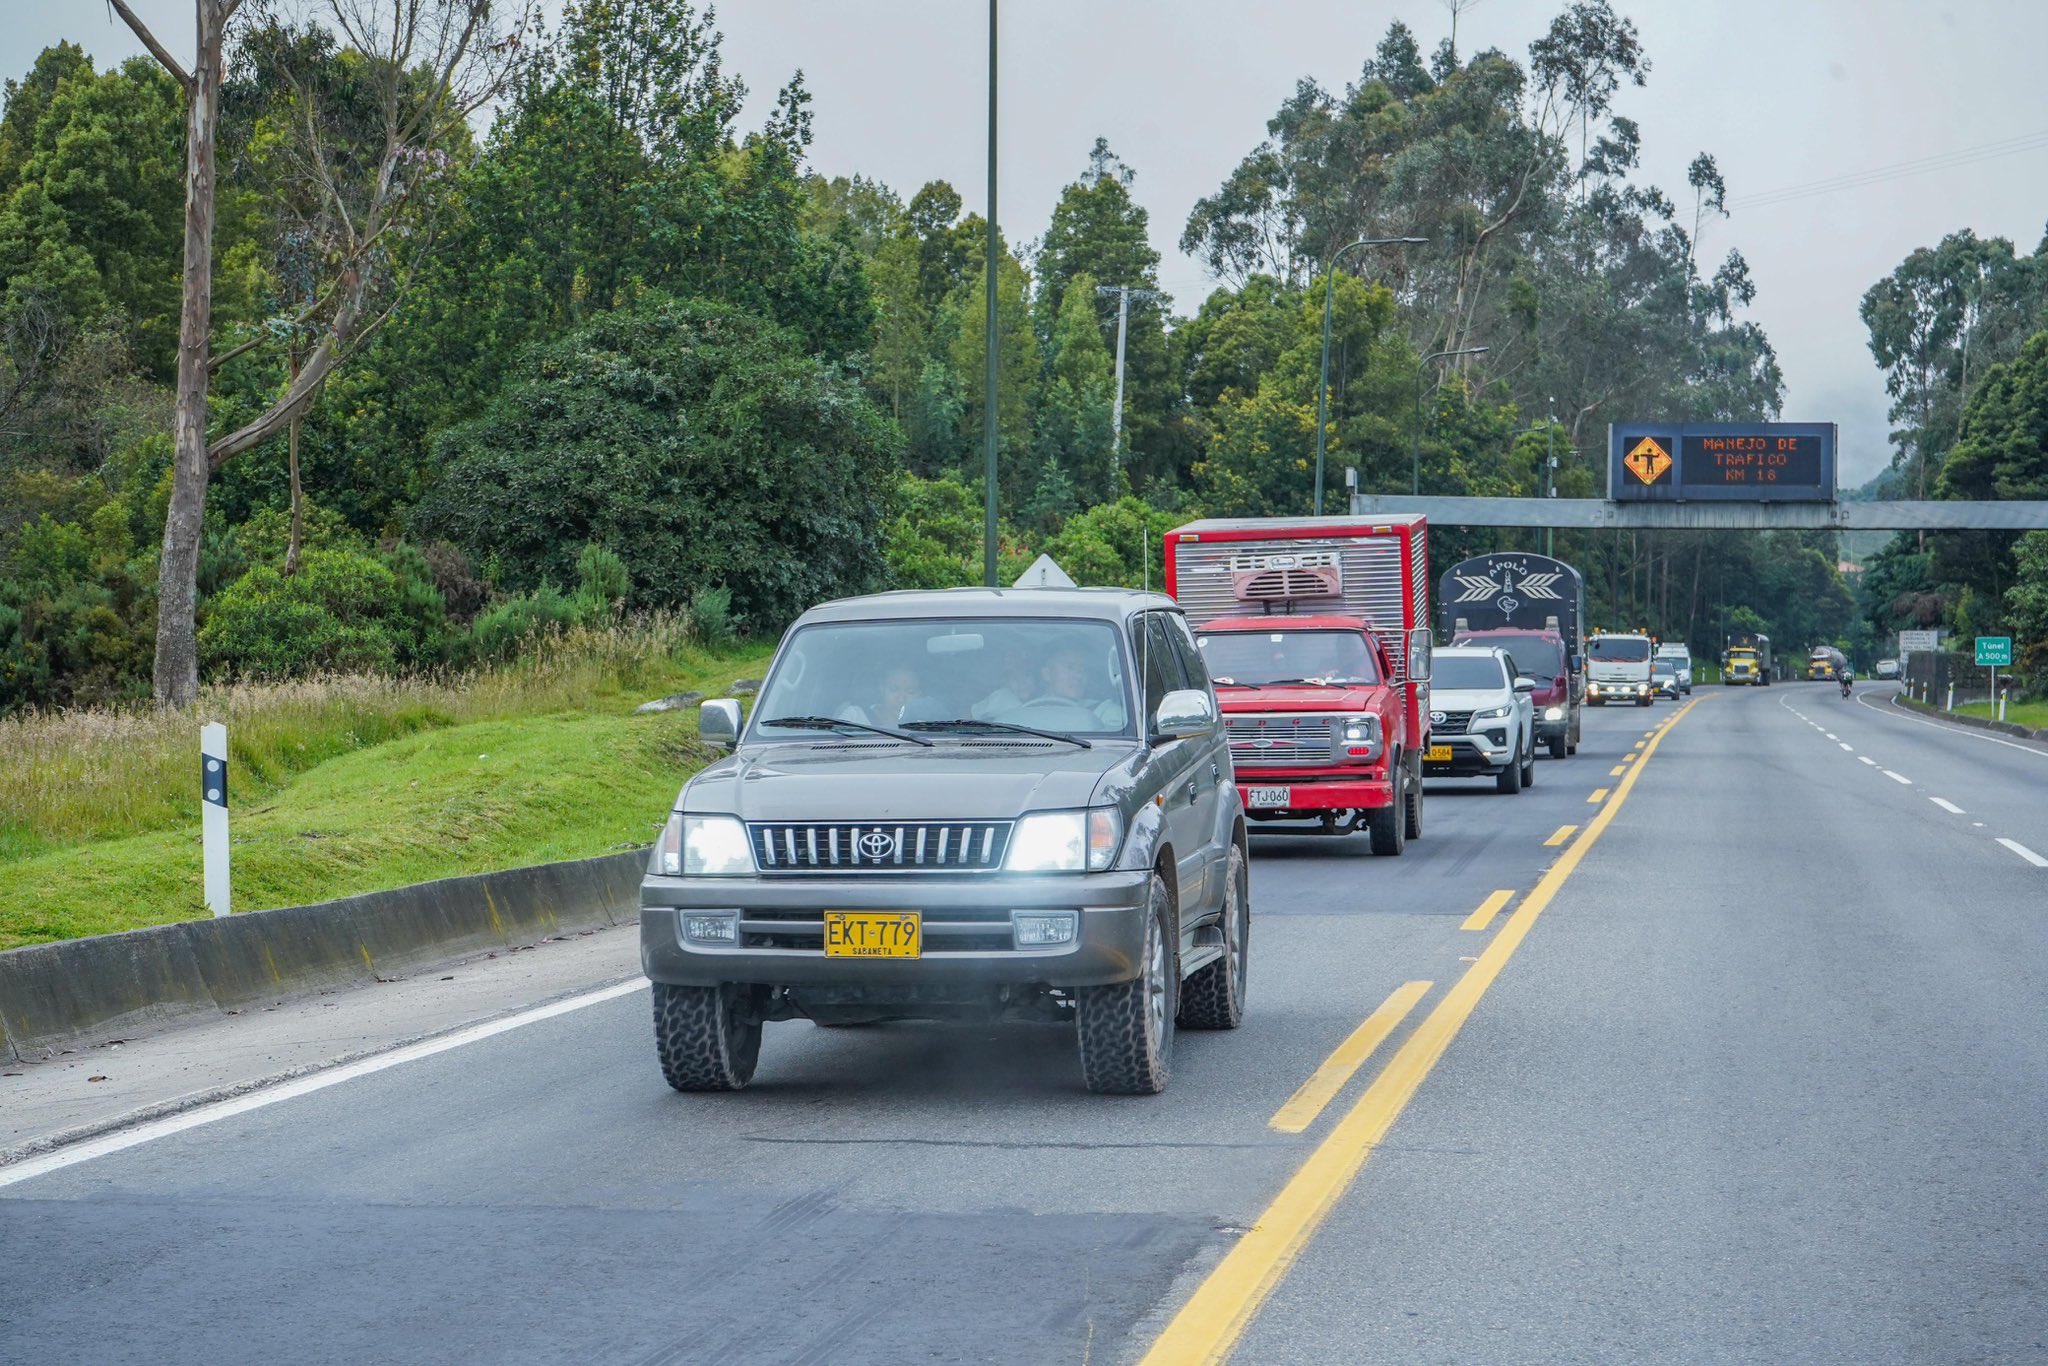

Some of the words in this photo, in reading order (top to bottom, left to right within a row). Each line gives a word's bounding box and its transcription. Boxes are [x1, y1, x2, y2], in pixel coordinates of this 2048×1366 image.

[1703, 437, 1767, 450] MANEJO
[1777, 437, 1798, 450] DE
[1714, 454, 1787, 465] TRAFICO
[1726, 469, 1745, 481] KM
[1489, 561, 1527, 577] APOLO
[1985, 652, 2001, 660] 500
[852, 947, 892, 955] SABANETA
